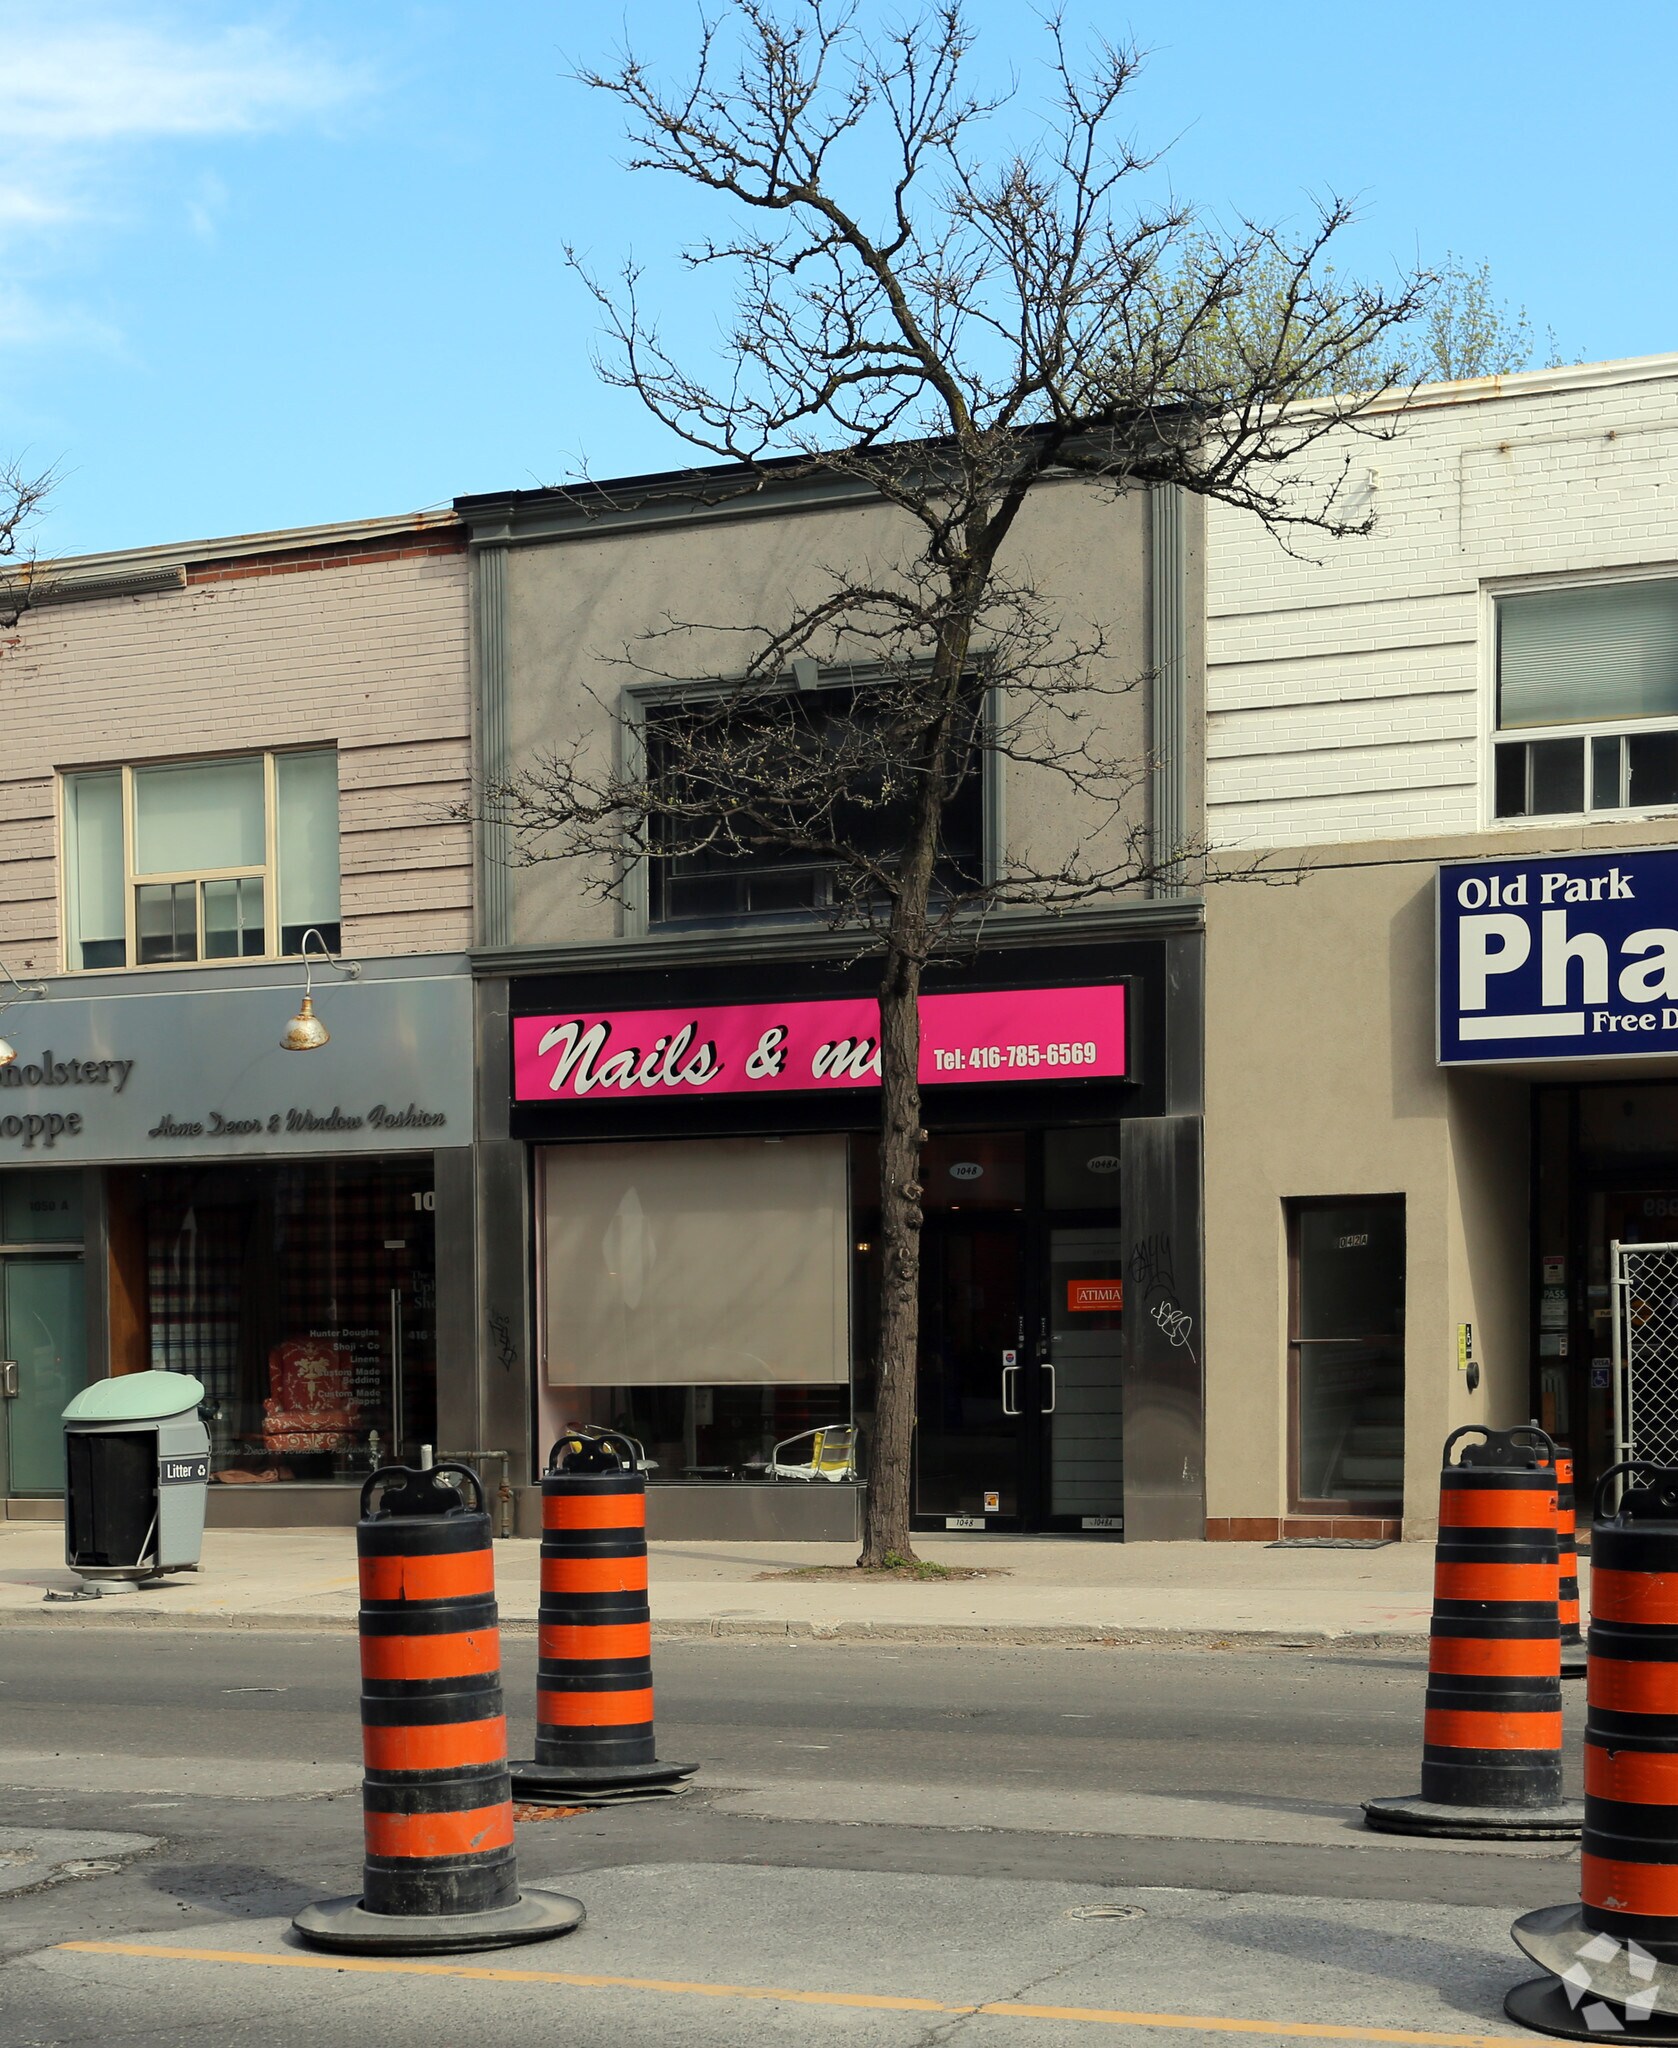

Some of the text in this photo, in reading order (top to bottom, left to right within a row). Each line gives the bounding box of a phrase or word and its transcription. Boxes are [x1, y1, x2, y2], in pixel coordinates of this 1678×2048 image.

[1457, 867, 1635, 909] Old Park
[1459, 909, 1678, 1011] Pha
[1592, 1011, 1656, 1034] Free
[538, 1018, 723, 1095] Nails
[744, 1025, 788, 1081] &
[934, 1041, 1097, 1071] Tel: 416-785-6569
[148, 1103, 446, 1137] Home Decor & Window Fashion
[0, 1112, 82, 1148] oppe
[1091, 1159, 1118, 1169] 1048A
[956, 1166, 977, 1175] 1048
[60, 1199, 69, 1210] A
[1079, 1289, 1121, 1301] ATIMIA
[1544, 1289, 1565, 1299] PASS
[309, 1328, 379, 1338] Hunter Douglas
[333, 1342, 356, 1352] Shoji
[367, 1342, 380, 1351] Co
[355, 1367, 381, 1376] Made
[342, 1376, 380, 1386] Bedding
[317, 1388, 381, 1398] Custom Made
[167, 1464, 192, 1479] Litter
[956, 1519, 973, 1527] 1048
